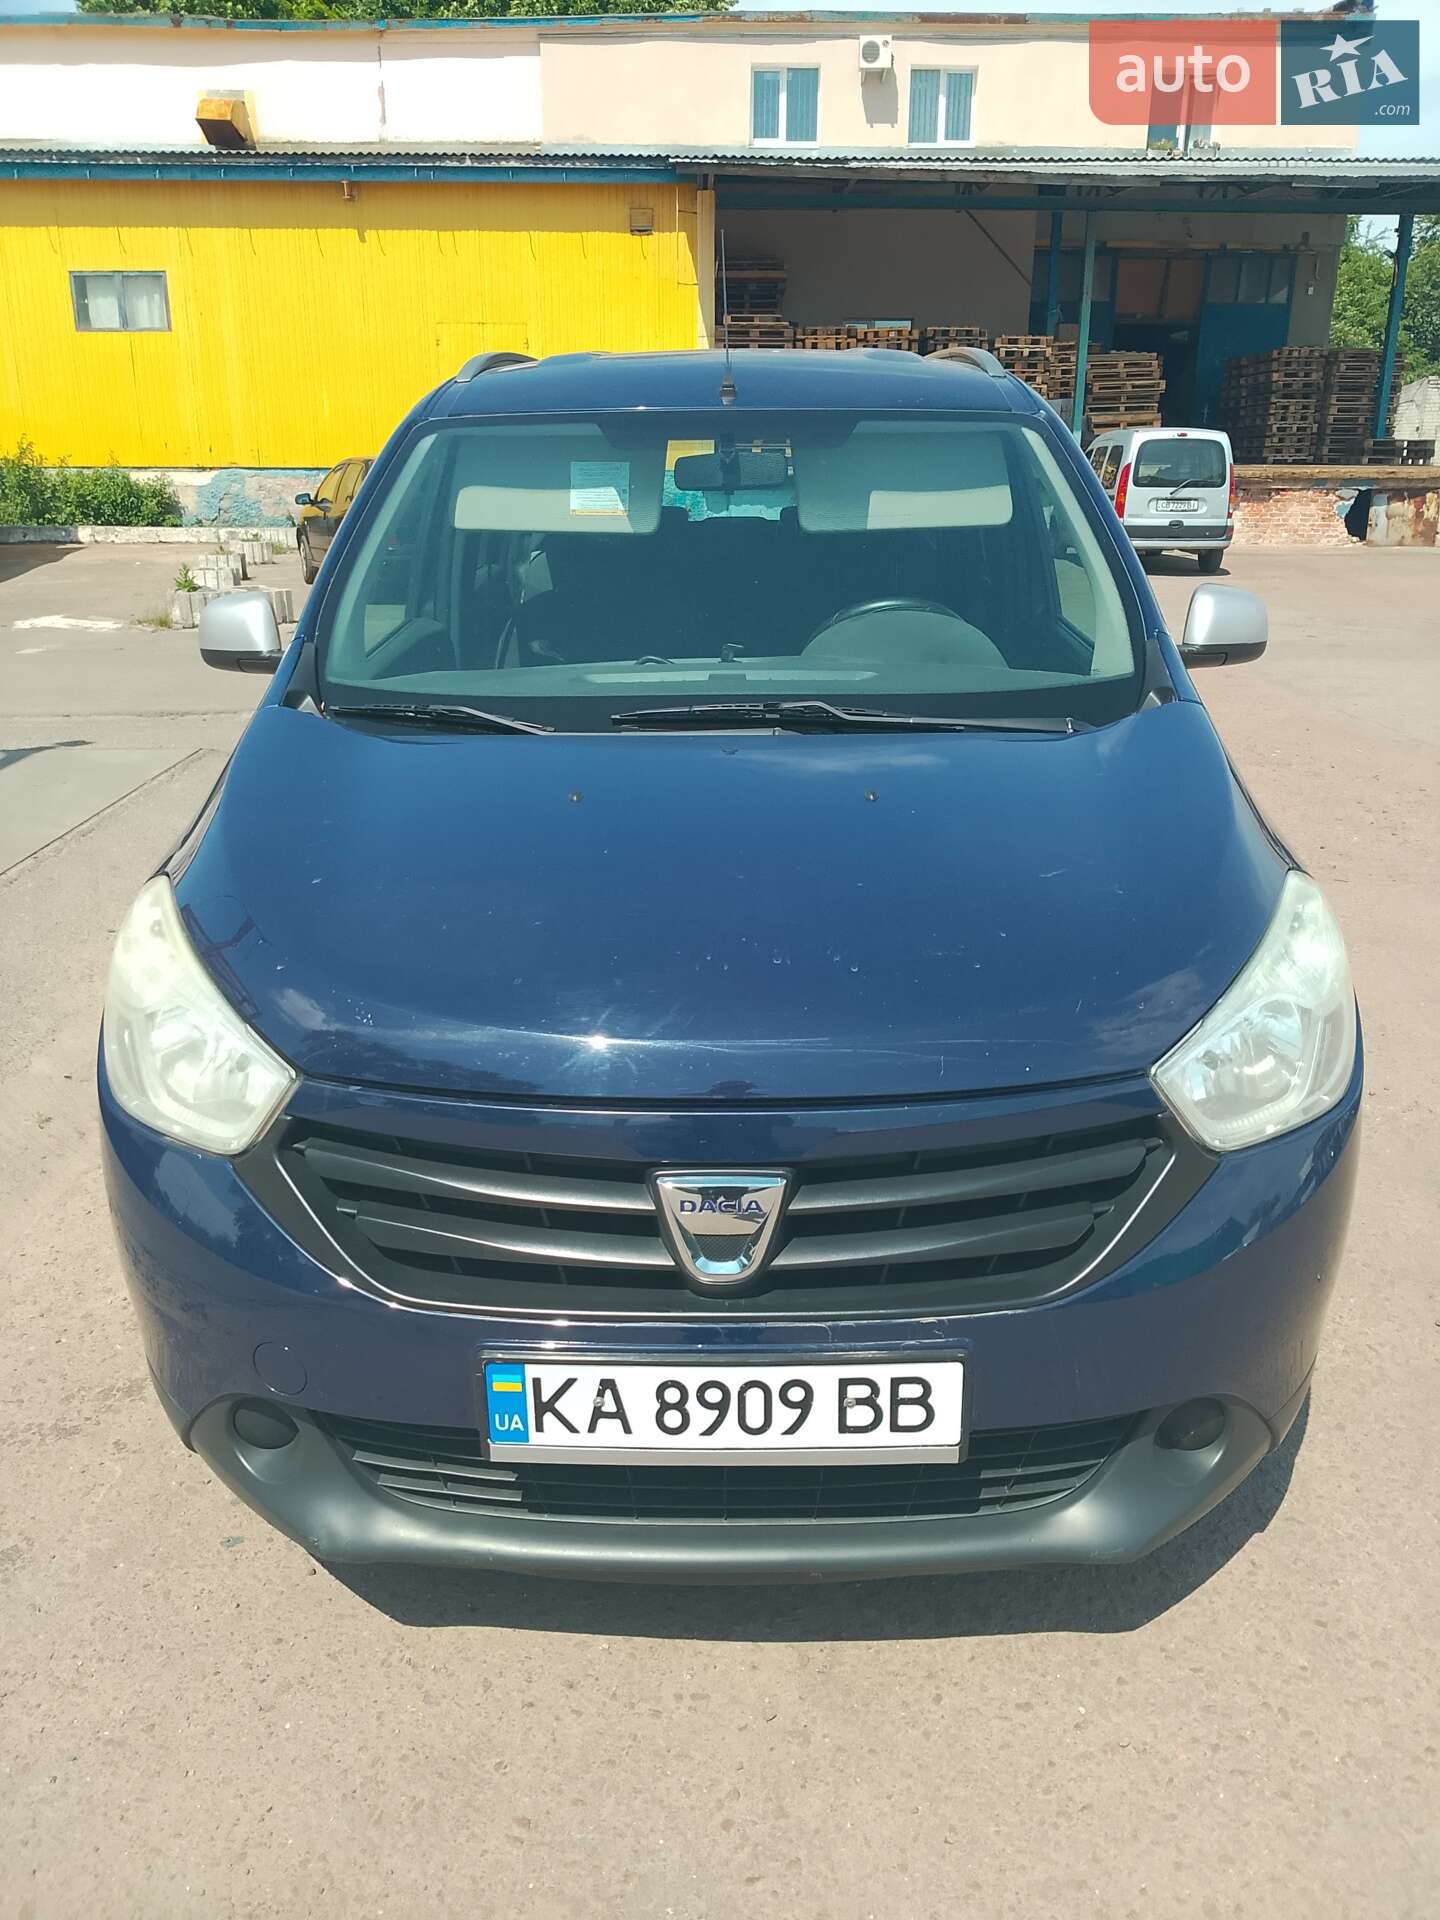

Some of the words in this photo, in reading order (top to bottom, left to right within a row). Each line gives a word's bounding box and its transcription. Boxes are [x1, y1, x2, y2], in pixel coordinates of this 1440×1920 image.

[679, 1200, 764, 1213] DACIA
[531, 1377, 633, 1435] KA
[654, 1379, 815, 1436] 8909
[836, 1376, 936, 1434] BB
[495, 1413, 526, 1432] UA
